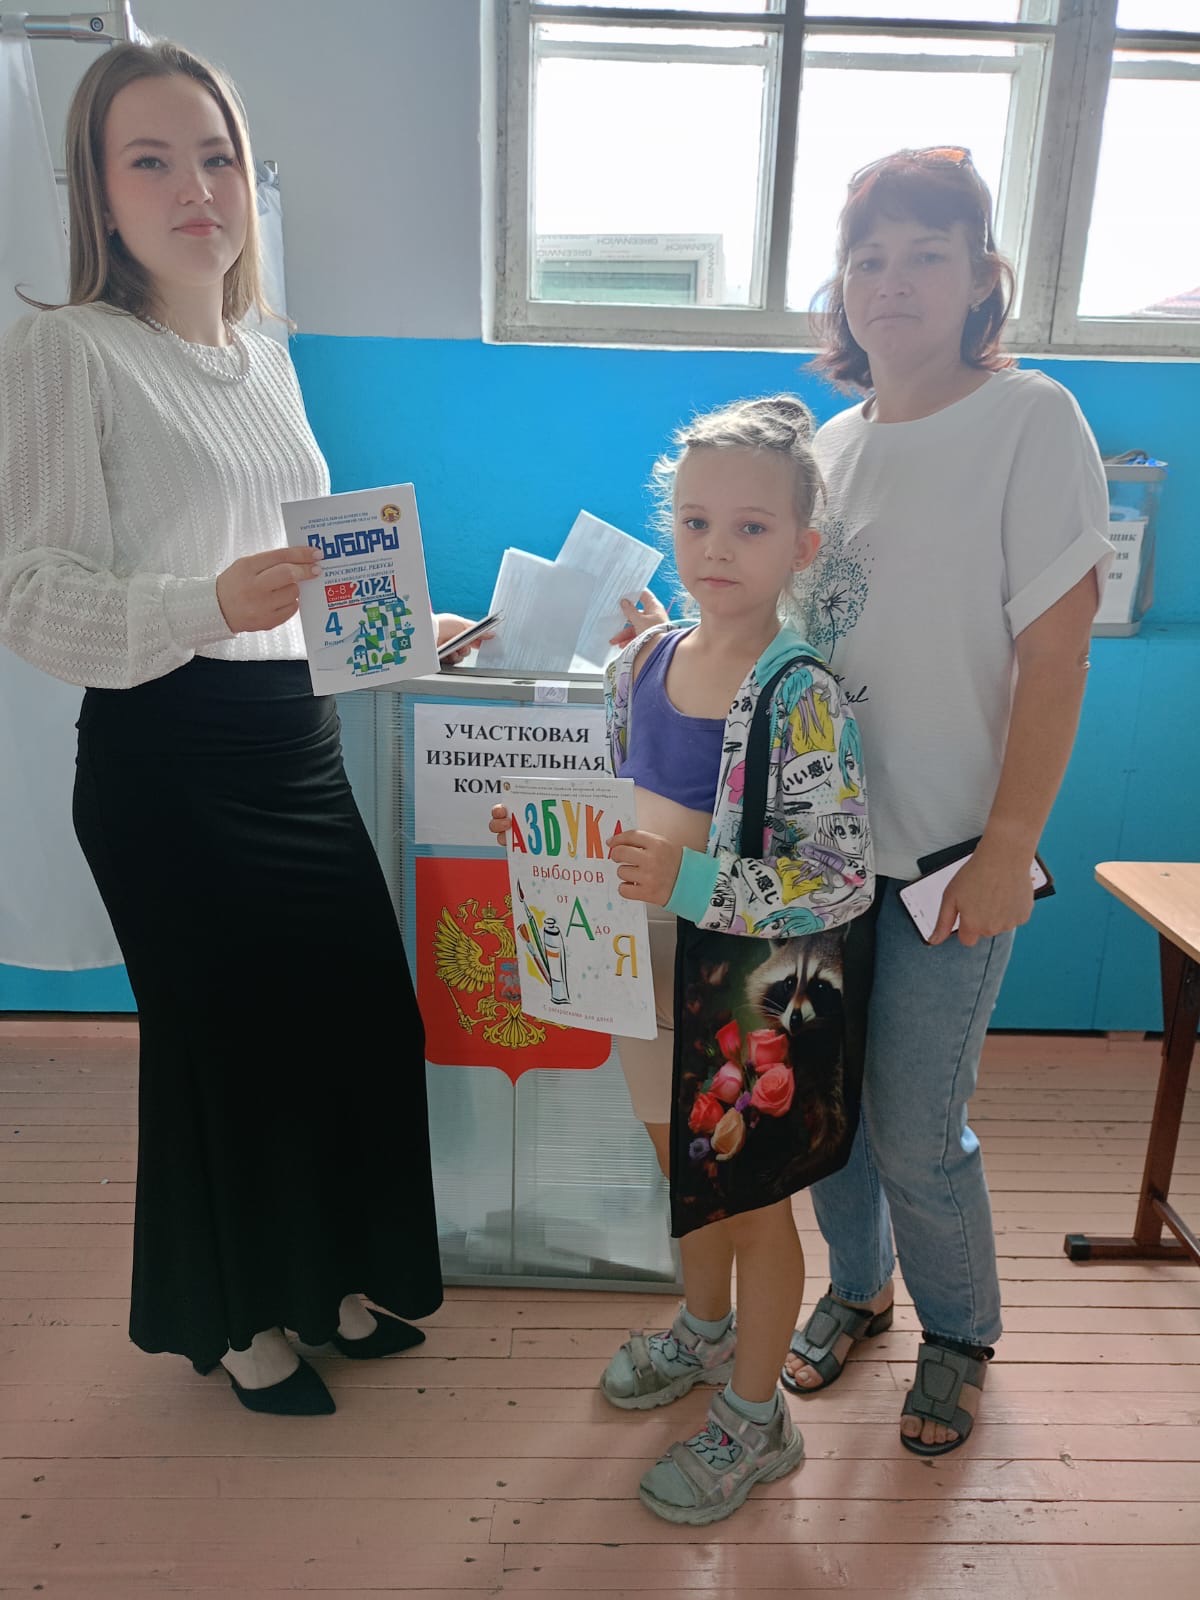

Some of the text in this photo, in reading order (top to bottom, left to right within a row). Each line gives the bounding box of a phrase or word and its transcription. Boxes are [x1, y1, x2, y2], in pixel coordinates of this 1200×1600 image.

[307, 526, 400, 560] ВЫБОРЫ
[327, 584, 346, 597] 6-8
[352, 576, 392, 598] 2024
[325, 611, 343, 636] 4
[444, 723, 589, 744] УЧАСТКОВАЯ
[425, 749, 605, 772] ИЗБИРАТЕЛЬНАЯ
[782, 755, 834, 792] いい感じ
[453, 778, 502, 795] КОМ
[532, 864, 605, 885] выборов
[556, 894, 638, 978] от А до Я
